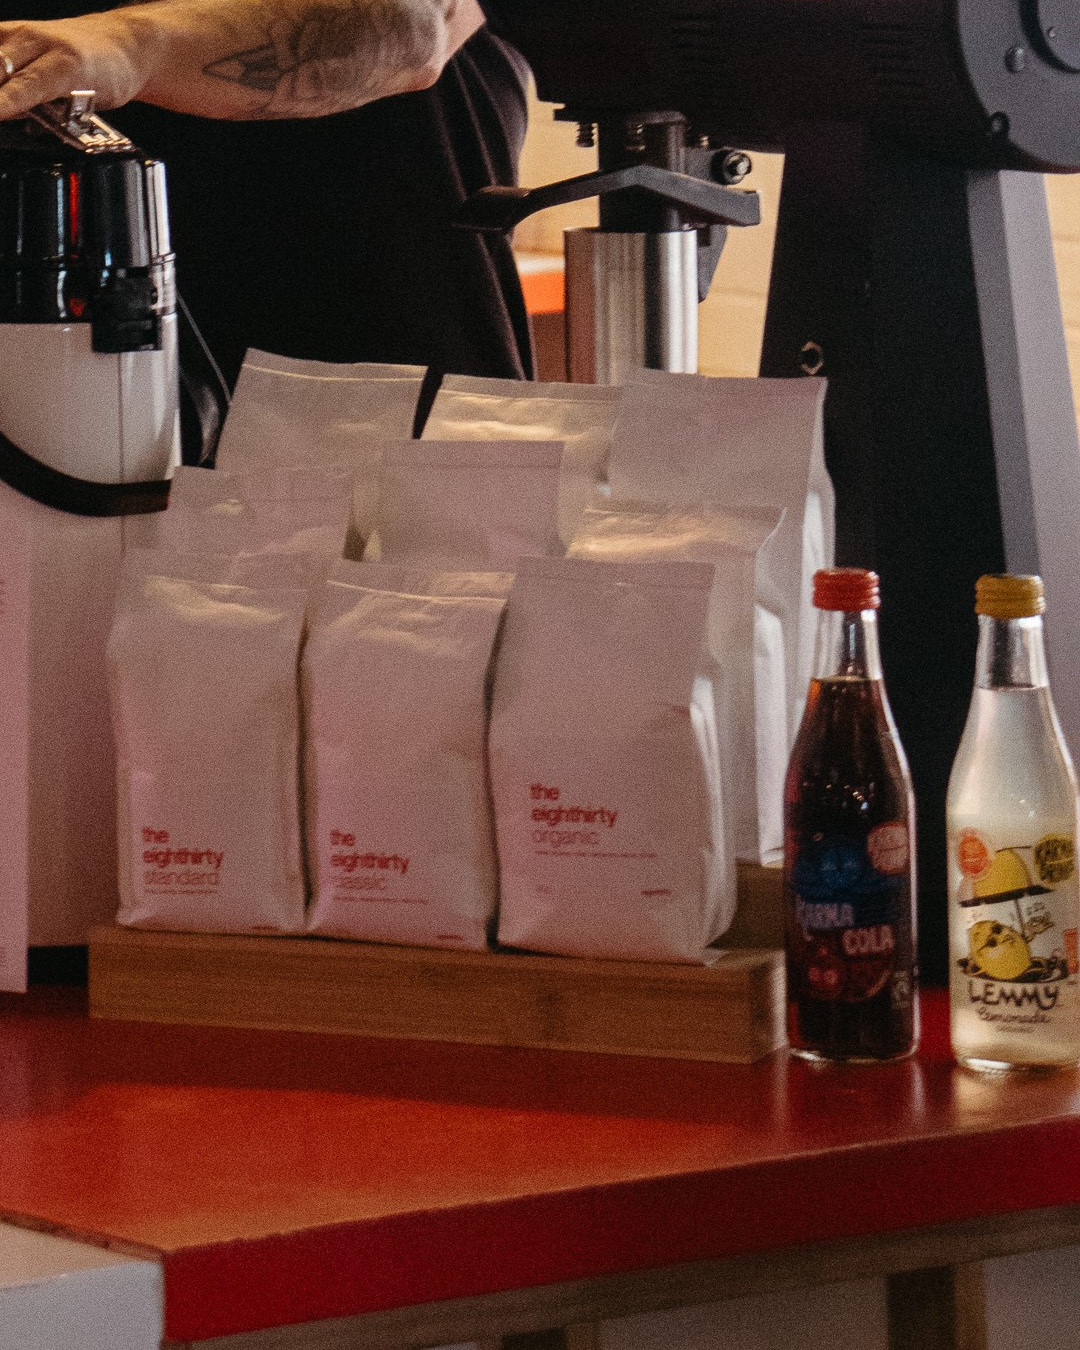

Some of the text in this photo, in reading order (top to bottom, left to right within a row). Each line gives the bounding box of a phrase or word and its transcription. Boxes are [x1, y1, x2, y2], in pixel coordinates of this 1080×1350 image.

[530, 783, 560, 801] the
[142, 826, 170, 844] the
[330, 829, 357, 847] the
[531, 828, 600, 847] organic
[843, 924, 896, 956] COLA
[967, 979, 1060, 1011] LEMMY
